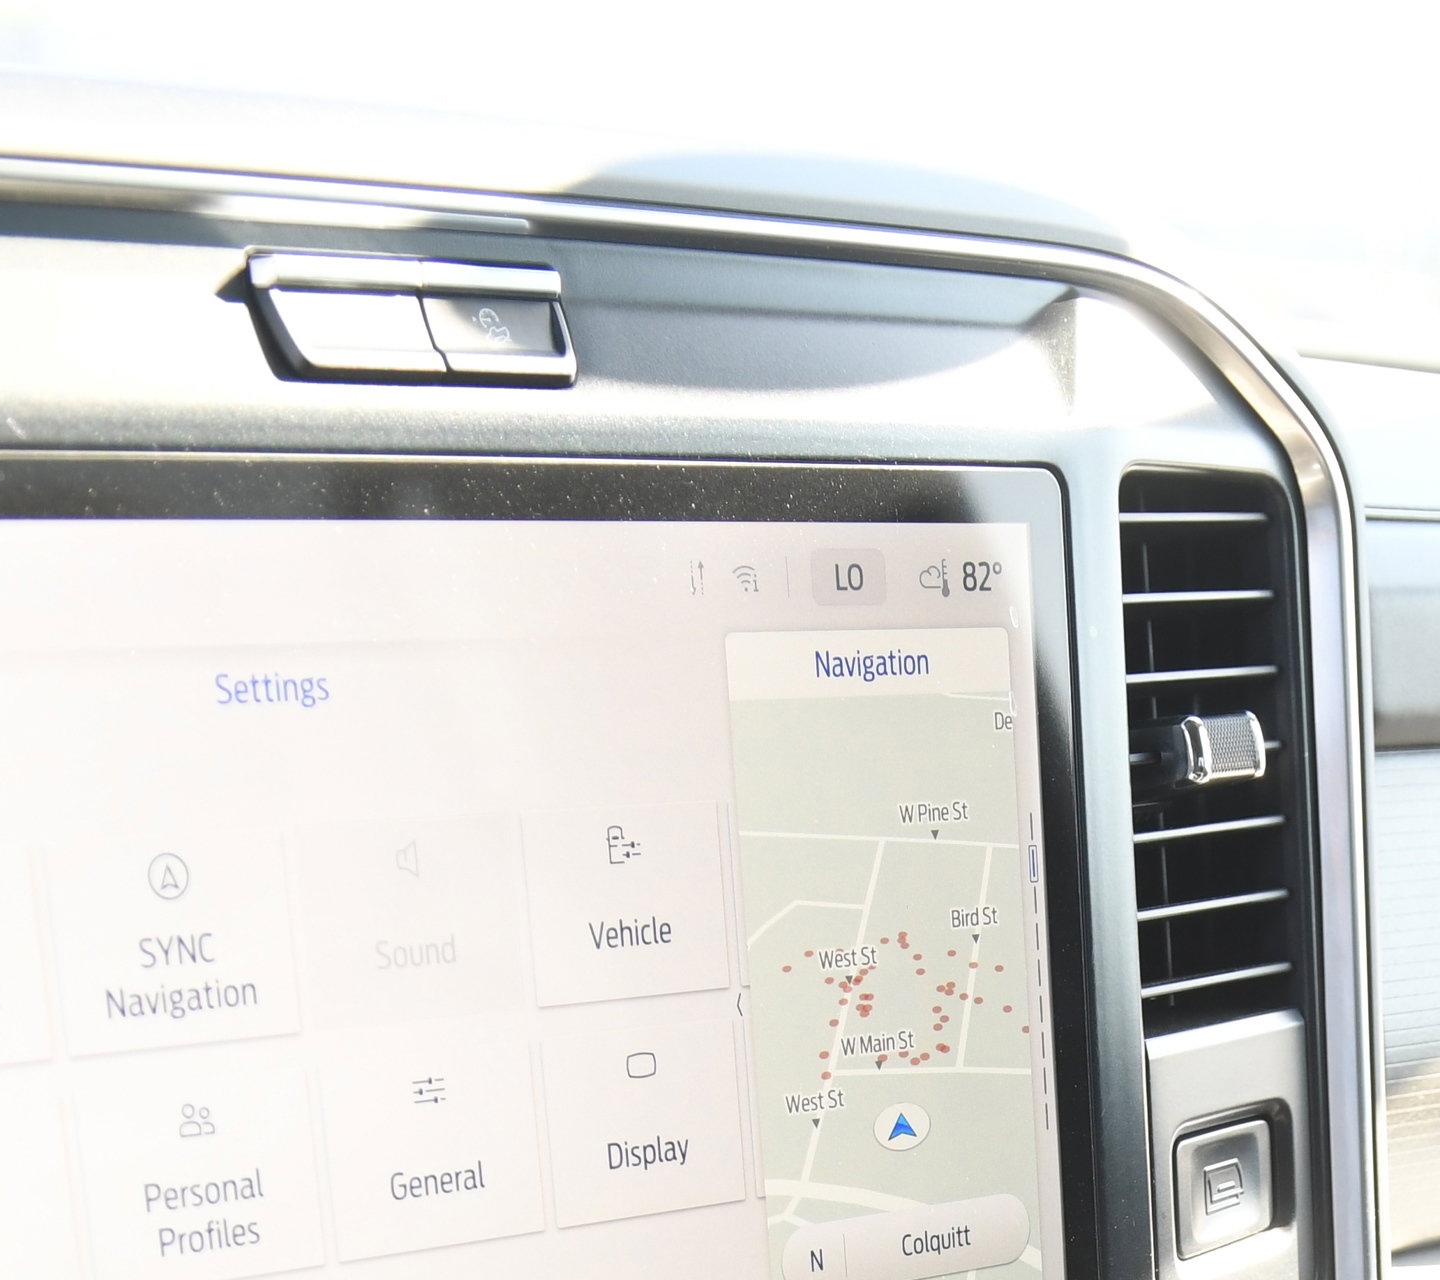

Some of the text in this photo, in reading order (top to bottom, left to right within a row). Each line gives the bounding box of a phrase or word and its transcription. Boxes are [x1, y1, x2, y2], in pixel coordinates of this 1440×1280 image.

[834, 563, 864, 593] LO
[815, 649, 930, 683] Navigation
[215, 672, 329, 707] Settings
[899, 801, 968, 823] W Pine St
[589, 915, 672, 951] Vehicle
[951, 906, 998, 928] Bird St
[138, 932, 216, 968] SYNC
[374, 934, 457, 970] Sound
[819, 946, 877, 969] West St
[105, 978, 258, 1020] Navigation
[841, 1031, 914, 1056] W Main St
[786, 1090, 844, 1113] West St
[607, 1134, 689, 1171] Display
[144, 1168, 264, 1213] Personal
[390, 1160, 486, 1202] General
[158, 1217, 260, 1257] Profiles
[902, 1225, 971, 1257] Colquitt
[810, 1249, 824, 1272] N
